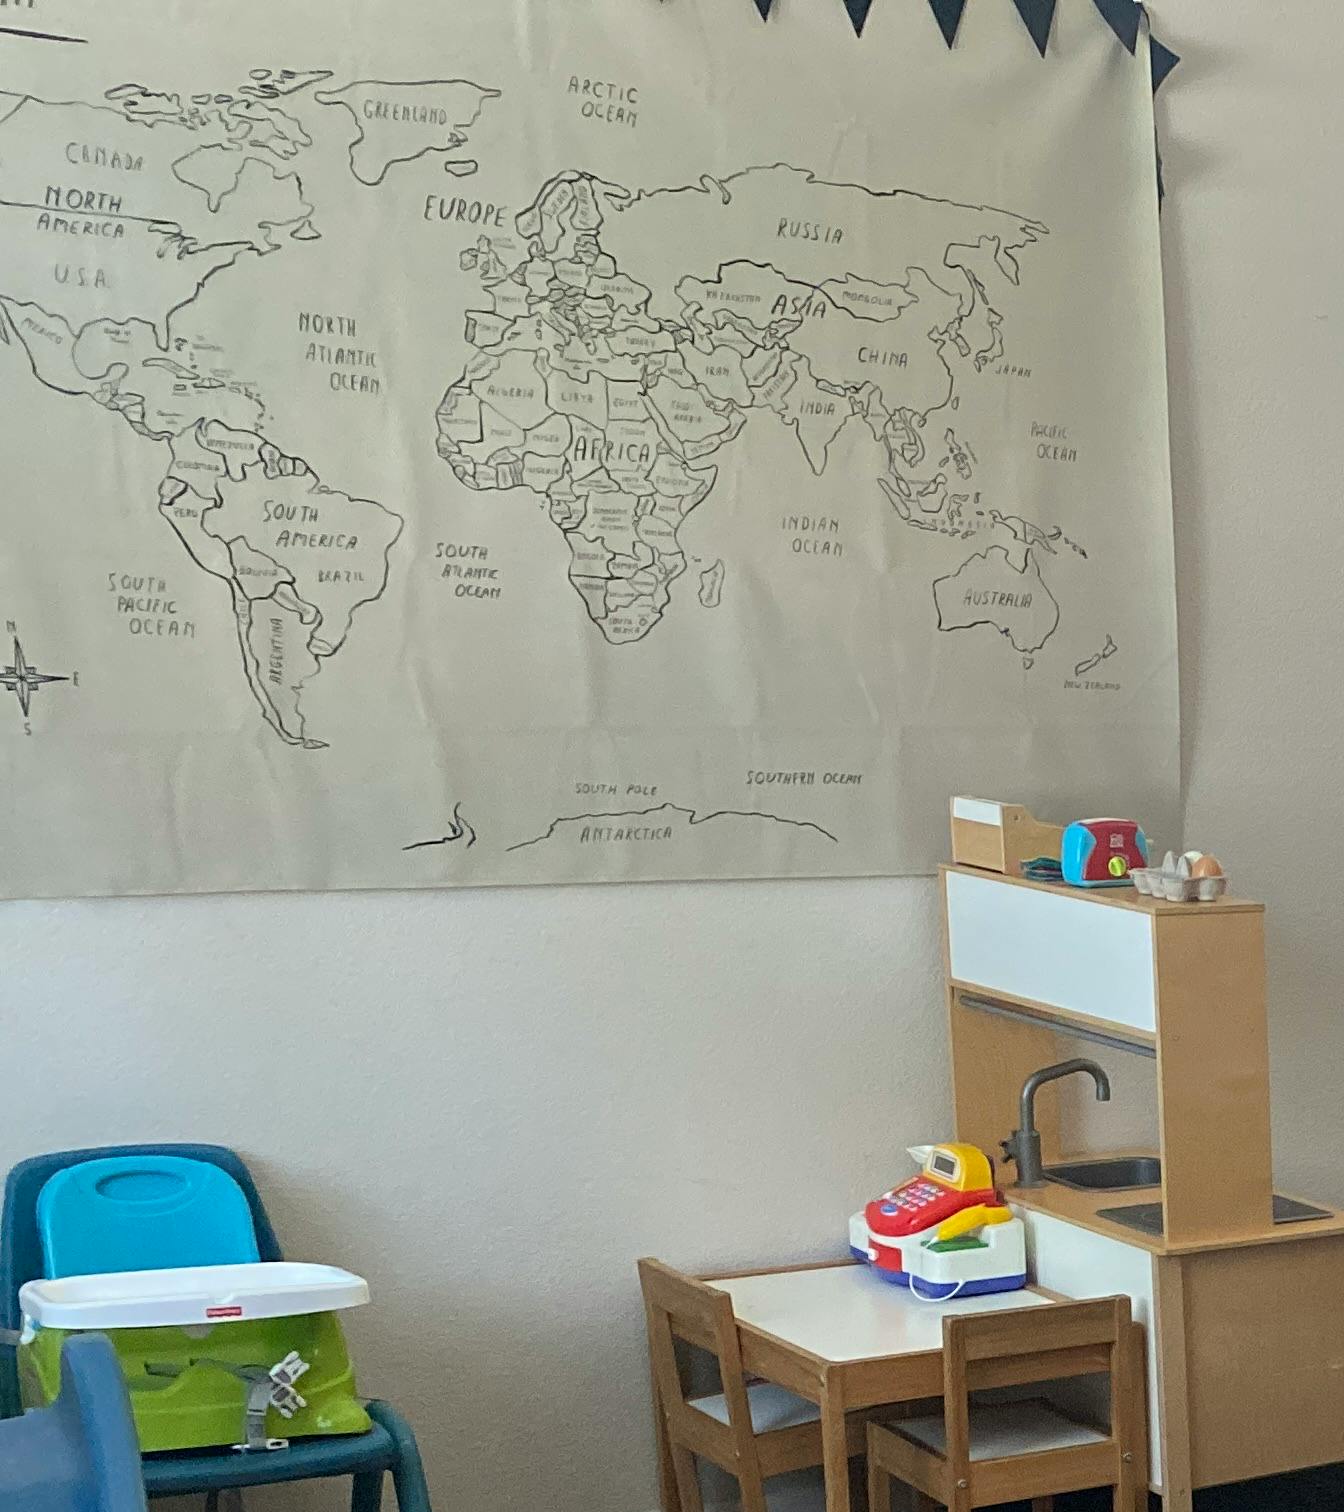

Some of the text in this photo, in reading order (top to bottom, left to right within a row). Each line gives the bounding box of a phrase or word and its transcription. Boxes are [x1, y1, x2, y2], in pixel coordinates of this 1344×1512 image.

[568, 76, 639, 104] ARCTIC
[363, 100, 449, 126] GREENLAND
[581, 102, 638, 128] OCEAN
[66, 142, 143, 172] CANADA
[45, 185, 123, 212] NORTH
[424, 195, 508, 229] EUROPE
[37, 214, 126, 239] AMERICA
[777, 217, 845, 246] RUSSIA
[771, 294, 827, 319] ASIA
[298, 312, 357, 338] NORTH
[305, 343, 377, 368] ATLANTIC
[858, 346, 908, 368] CHINA
[330, 371, 380, 394] OCEAN
[800, 400, 835, 416] INDIA
[574, 436, 650, 462] AFRICA
[1037, 443, 1077, 462] OCEAN
[262, 500, 319, 523] SOUTH
[781, 516, 839, 535] INDIAN
[275, 530, 358, 551] AMERICA
[434, 542, 488, 561] SOUTH
[792, 538, 843, 558] OCEAN
[107, 572, 167, 594] SOUTH
[318, 570, 364, 583] BRAZIL
[442, 563, 500, 581] ATLANTIC
[454, 583, 502, 599] OCEAN
[963, 587, 1033, 610] AUSTRALIA
[117, 597, 178, 616] PACIFIC
[129, 616, 196, 639] OCEAN
[269, 618, 284, 686] ARGENTINA
[23, 722, 32, 736] S
[575, 782, 658, 797] SOUTH POLE
[747, 770, 863, 787] SOUTHERN OCEAN
[580, 825, 673, 844] ANTARCTICA
